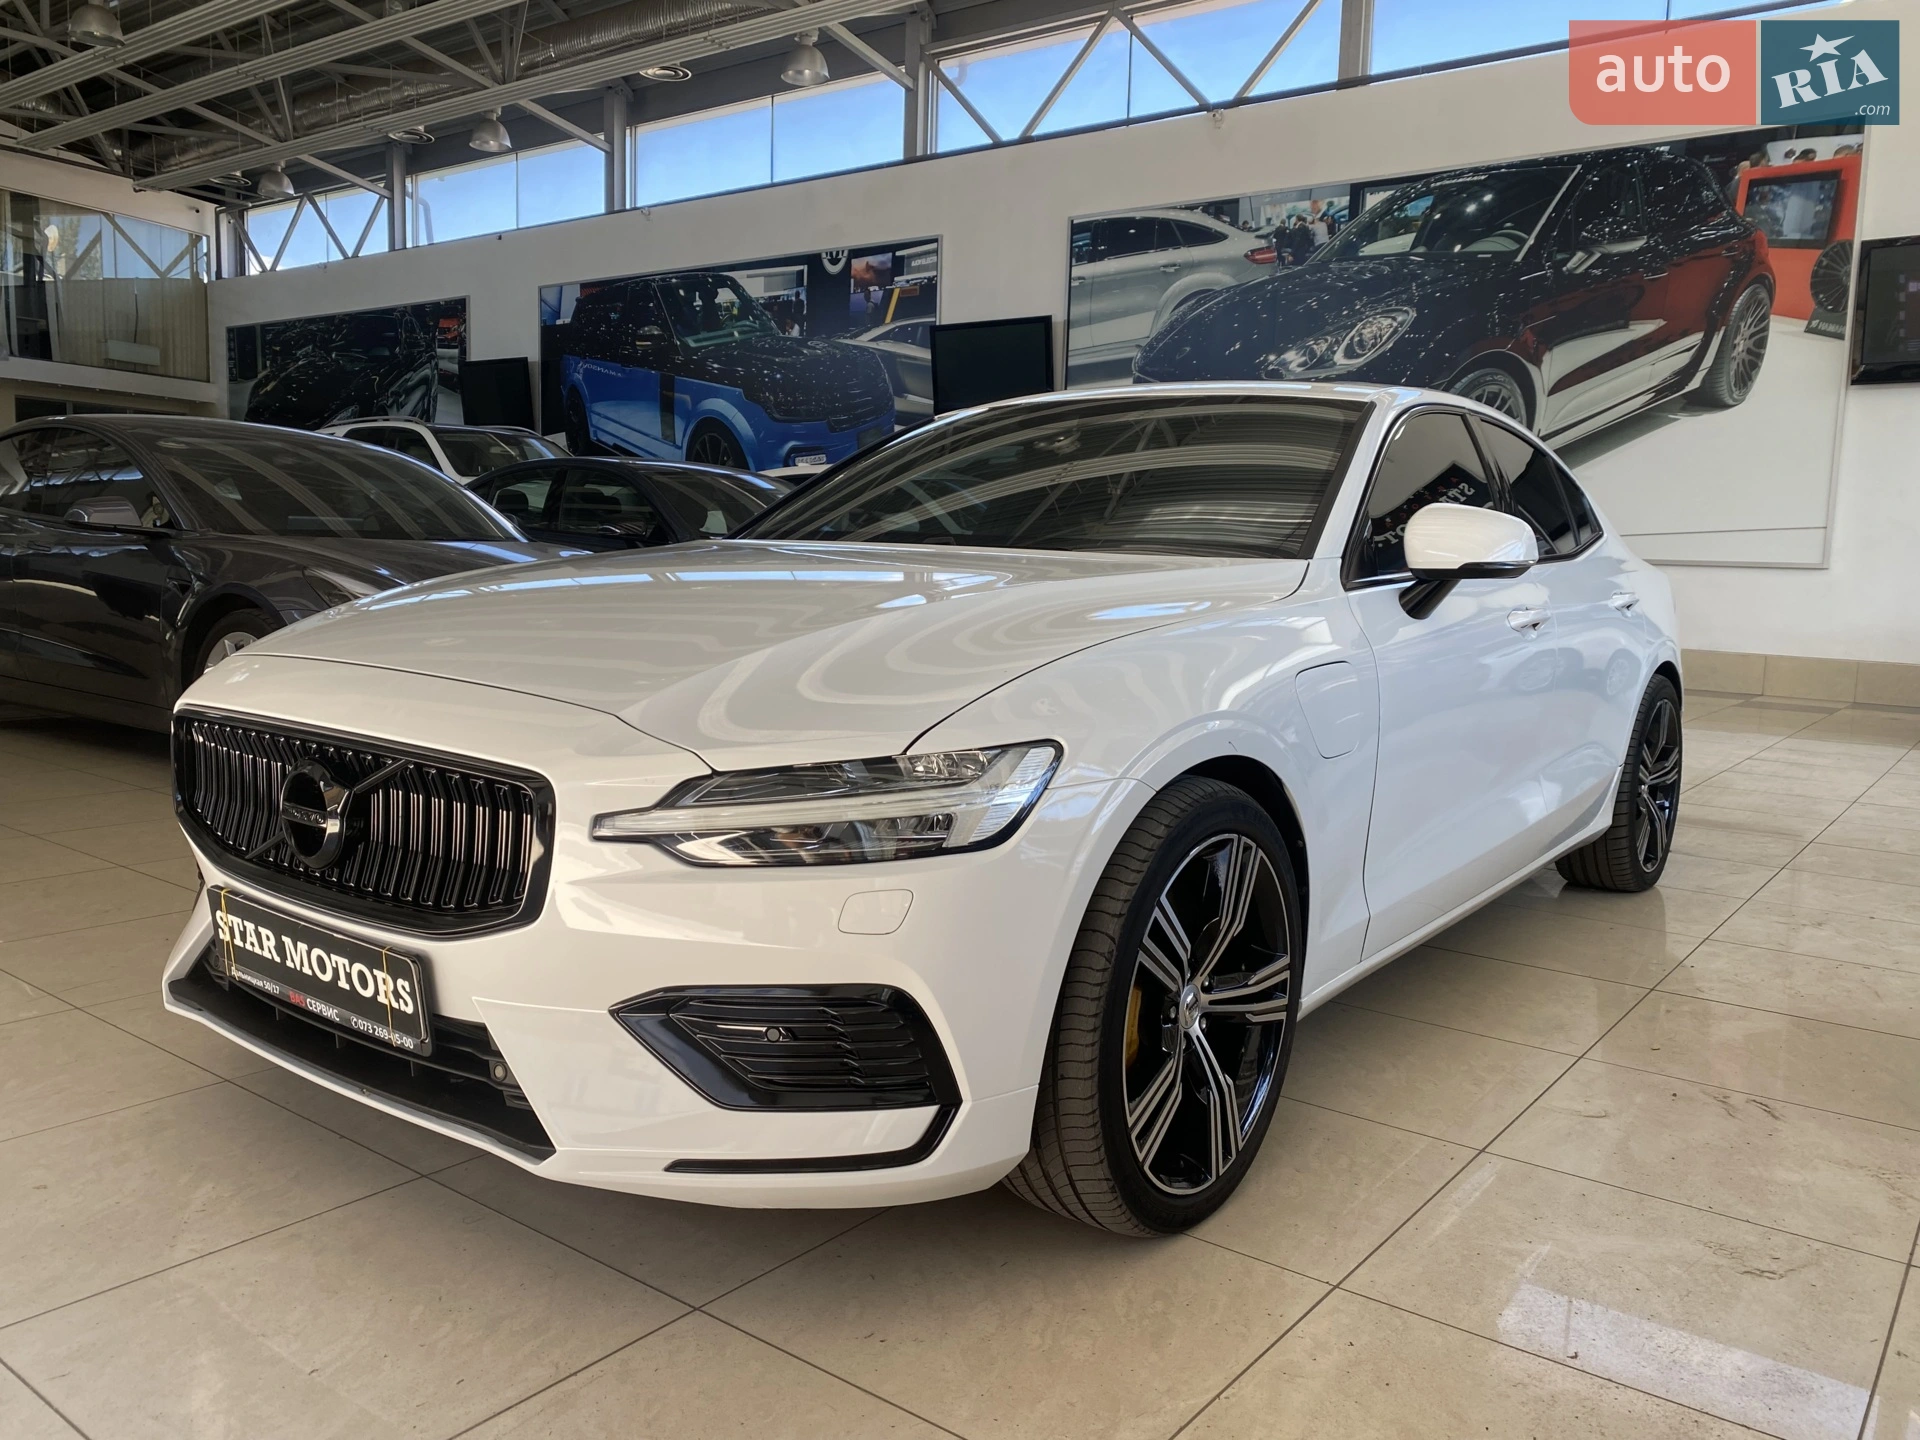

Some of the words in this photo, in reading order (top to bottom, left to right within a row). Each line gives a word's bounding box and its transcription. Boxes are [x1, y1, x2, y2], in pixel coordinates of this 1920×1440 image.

[215, 910, 281, 963] STAR
[281, 935, 414, 1015] MOTORS
[263, 980, 280, 995] 50/17
[306, 998, 340, 1021] СЕРВИС
[358, 1019, 373, 1034] 073
